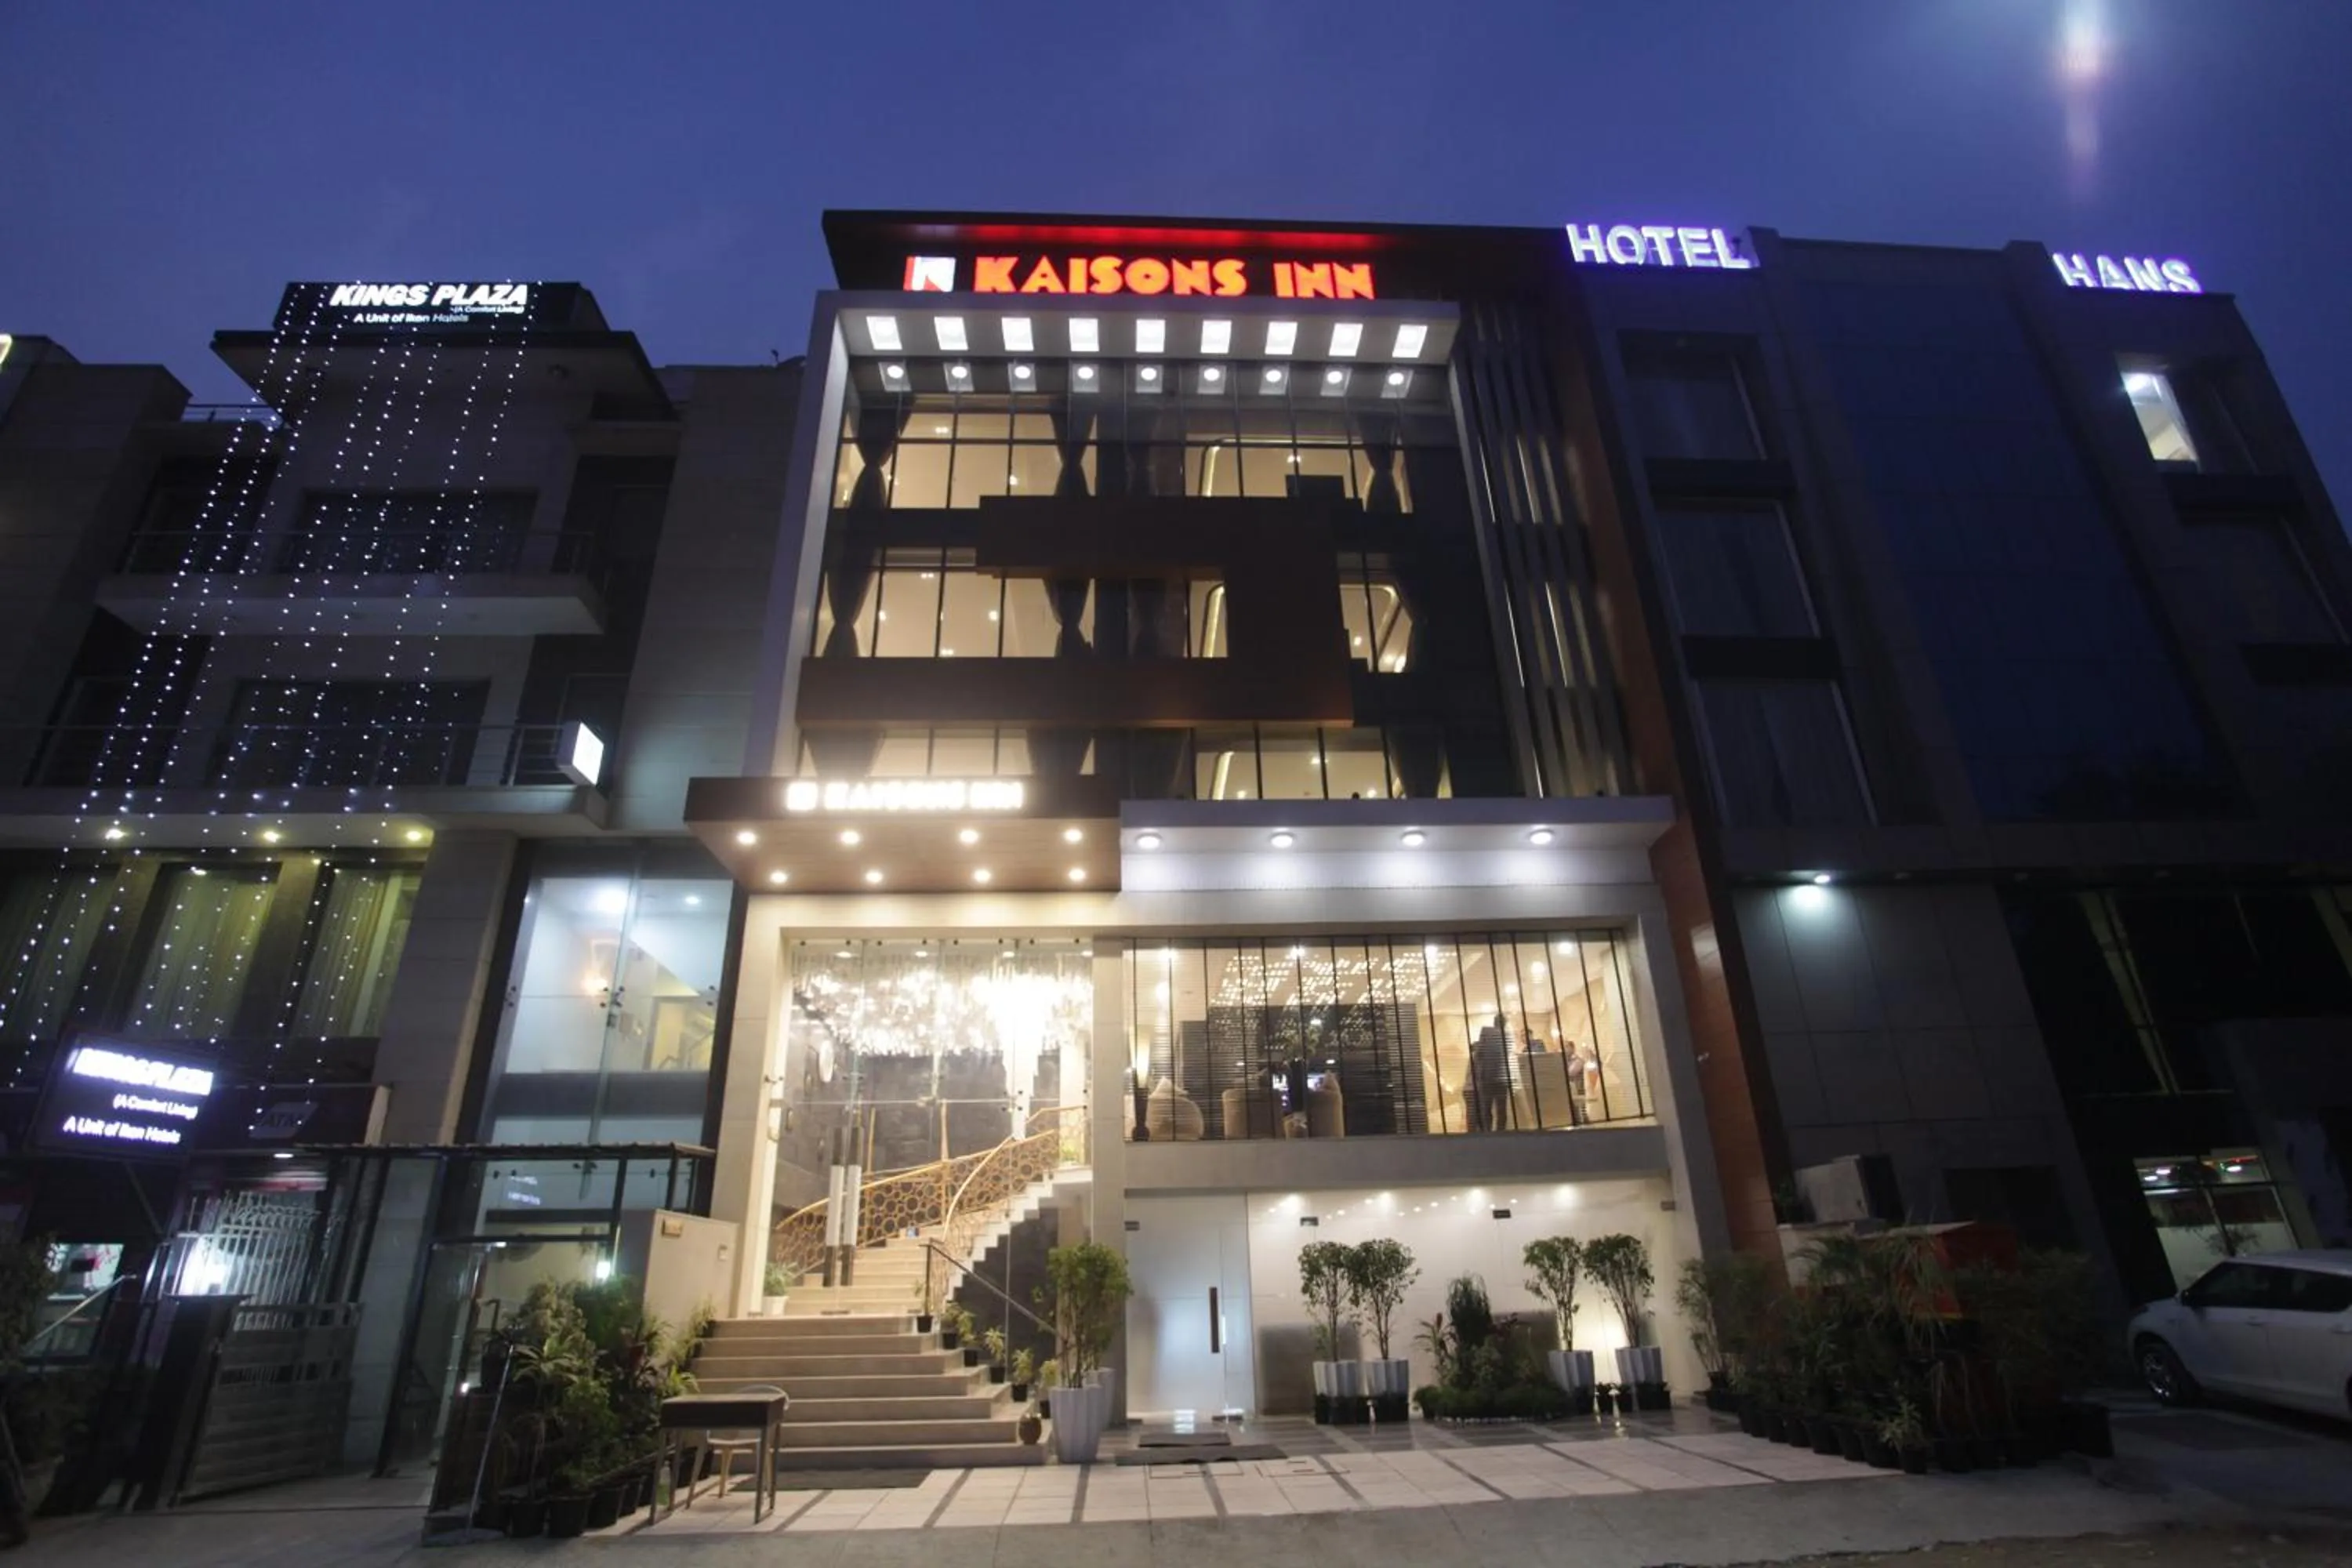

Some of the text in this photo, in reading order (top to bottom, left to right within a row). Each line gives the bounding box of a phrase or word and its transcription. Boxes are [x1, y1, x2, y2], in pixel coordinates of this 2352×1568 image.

[1566, 223, 2202, 292] HOTEL HANS
[973, 256, 1375, 299] KAISONS INN
[329, 284, 528, 306] KINGS PLAZA
[354, 314, 364, 323] A
[366, 314, 390, 323] Unit
[391, 314, 405, 323] of
[63, 1116, 76, 1132] A
